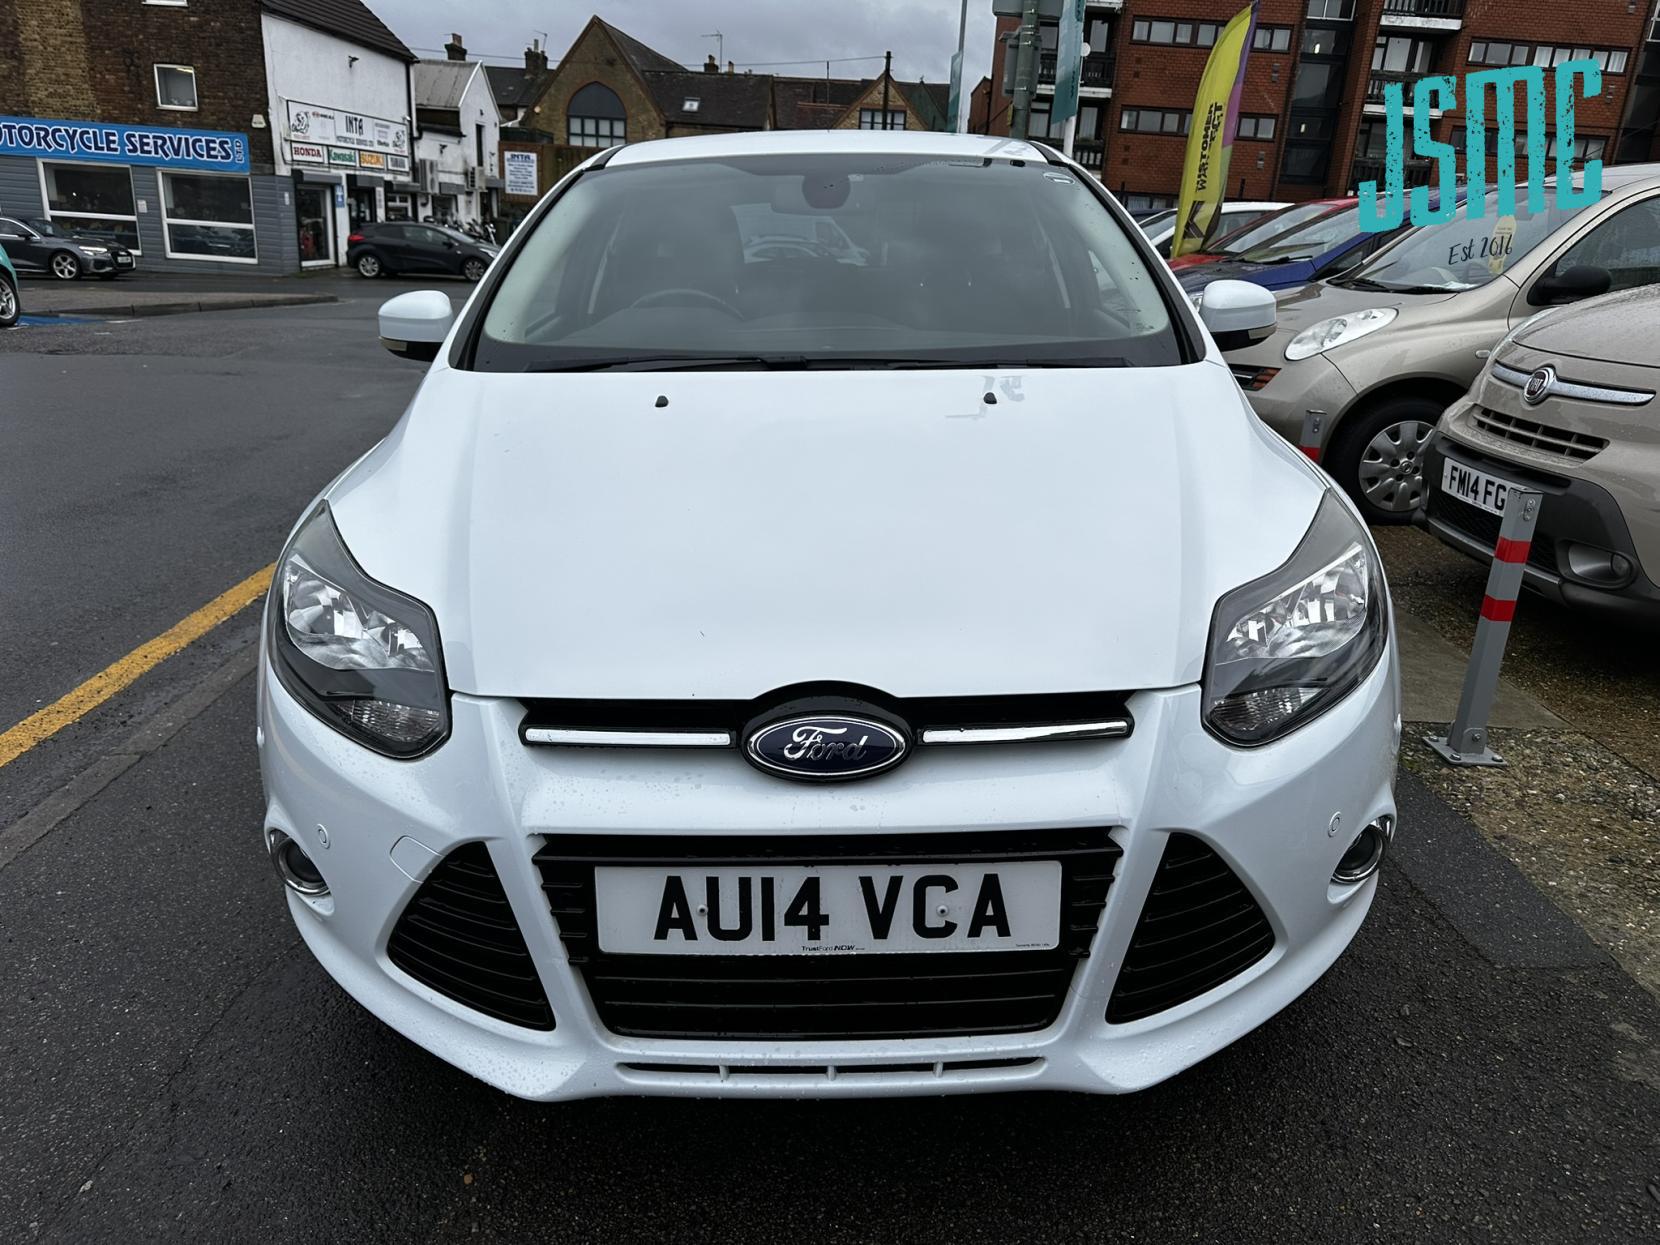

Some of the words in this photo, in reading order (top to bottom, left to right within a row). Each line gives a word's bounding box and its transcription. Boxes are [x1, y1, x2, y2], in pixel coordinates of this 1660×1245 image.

[0, 123, 119, 153] TORCYCLE
[124, 131, 233, 161] SERVICES
[235, 139, 244, 163] LTD
[345, 115, 364, 136] INTA
[293, 146, 322, 158] HONDA
[1448, 465, 1480, 501] FM14
[1483, 479, 1507, 511] FG
[783, 725, 869, 761] Ford
[653, 875, 830, 942] AU14
[858, 873, 1011, 940] VCA
